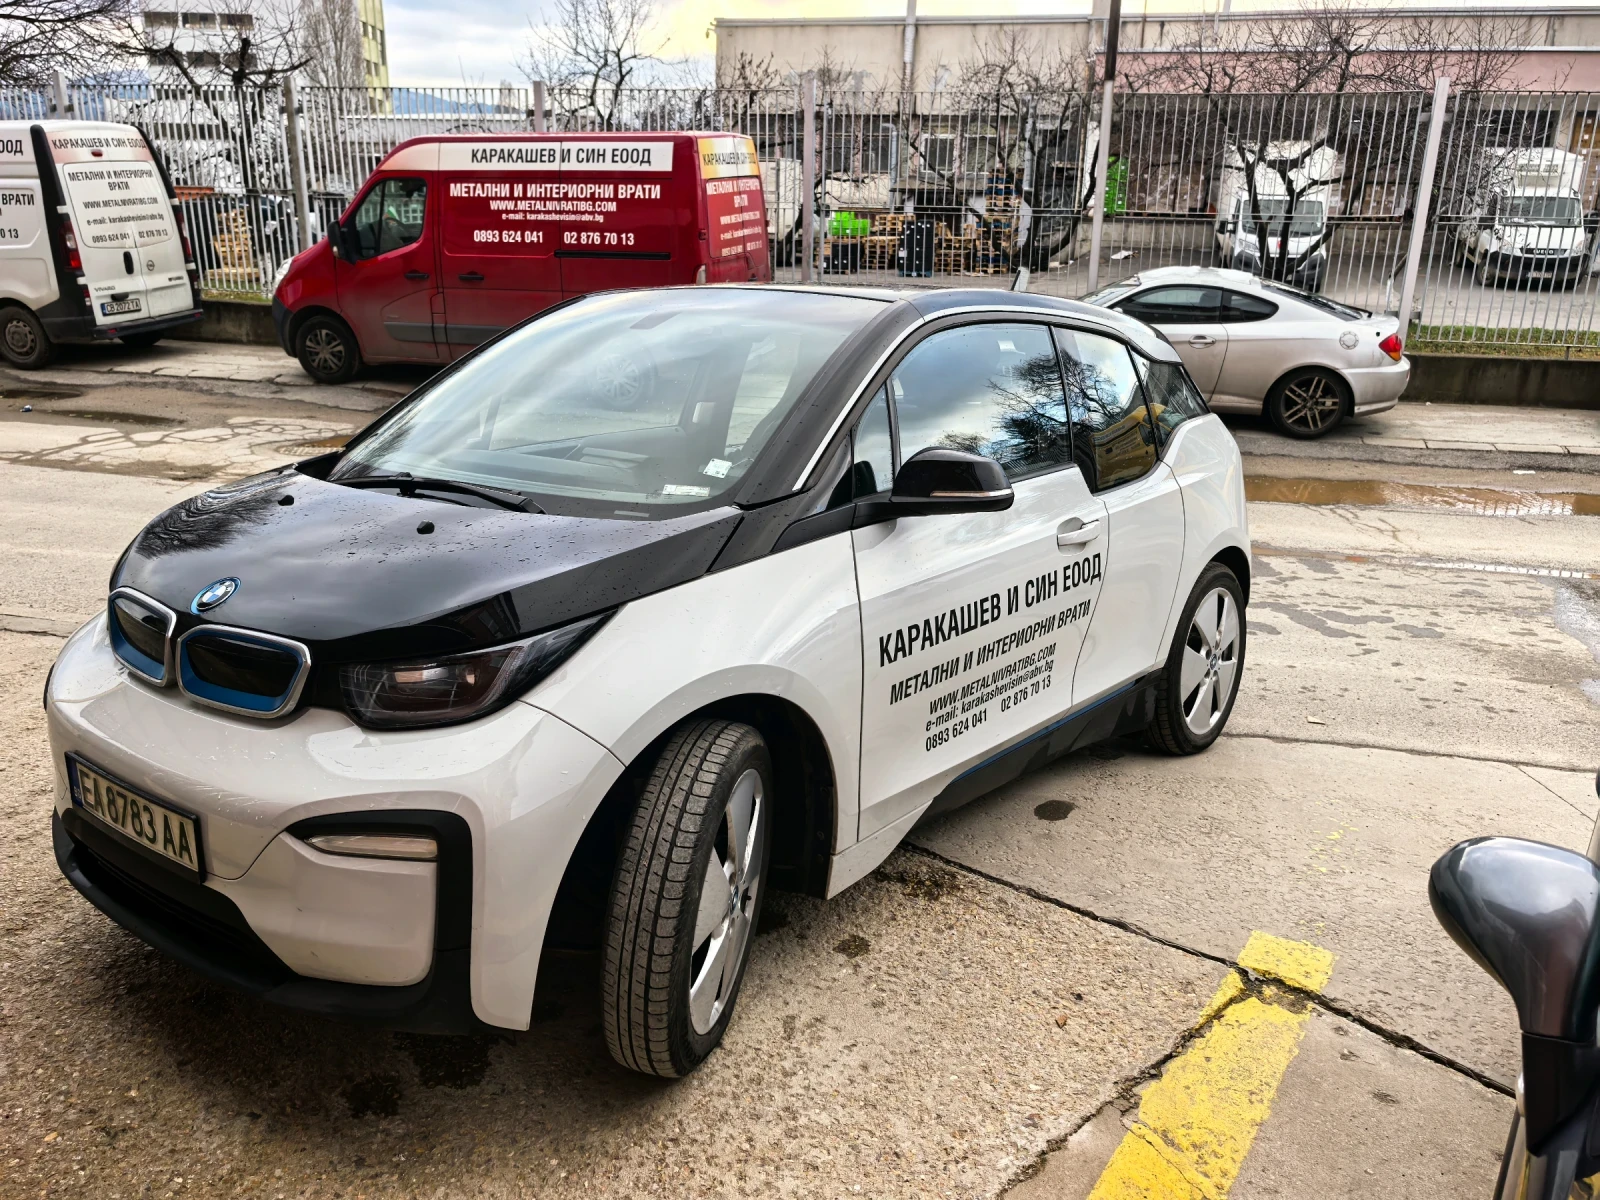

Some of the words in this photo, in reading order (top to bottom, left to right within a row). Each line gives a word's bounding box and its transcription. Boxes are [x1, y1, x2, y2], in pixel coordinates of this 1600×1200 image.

[52, 138, 104, 149] КАРАКАШЕВ
[103, 138, 111, 148] И
[111, 138, 126, 148] СИН
[127, 139, 148, 150] ЕООД
[471, 148, 556, 163] КАРАКАШЕВ
[561, 148, 571, 163] И
[576, 148, 606, 163] СИН
[611, 148, 651, 166] ЕООД
[68, 171, 106, 181] МЕТАЛНИ
[106, 170, 112, 180] И
[112, 170, 154, 179] ИНТЕРИОРНИ
[108, 181, 130, 191] ВРАТИ
[450, 183, 510, 197] МЕТАЛНИ
[514, 184, 524, 198] И
[526, 184, 614, 198] ИНТЕРИОРНИ
[618, 184, 661, 199] ВРАТИ
[2, 194, 35, 206] ВРАТИ
[490, 200, 617, 212] WWW.METALNIVRATIBG.COM
[87, 216, 108, 226] e-mail:
[502, 212, 526, 220] e-mail:
[526, 212, 604, 222] karakashevisin@abv.bg
[8, 229, 19, 238] 13
[92, 235, 107, 244] 0893
[108, 234, 119, 242] 624
[120, 232, 130, 241] 041
[474, 230, 500, 242] 0893
[502, 230, 522, 243] 624
[525, 231, 544, 243] 041
[564, 232, 578, 244] 02
[580, 232, 600, 244] 876
[604, 233, 618, 245] 70
[620, 233, 634, 245] 13
[879, 593, 1001, 667] КАРАКАШЕВ
[1007, 586, 1019, 616] И
[1025, 570, 1058, 608] СИН
[1063, 553, 1102, 593] ЕООД
[890, 656, 960, 705] МЕТАЛНИ
[963, 651, 974, 673] И
[976, 614, 1056, 666] ИНТЕРИОРНИ
[1057, 599, 1092, 630] ВРАТИ
[930, 642, 1057, 715] WWW.METALNIVRATIBG.COM
[926, 708, 959, 732] e-mail:
[961, 659, 1054, 714] karakashevisin@abv.bg
[1001, 698, 1012, 712] 02
[1014, 686, 1028, 706] 876
[1031, 681, 1040, 697] 70
[1042, 675, 1052, 690] 13
[926, 733, 950, 752] 0893
[952, 721, 970, 739] 624
[972, 708, 988, 728] 041
[106, 786, 157, 844] 8783
[164, 813, 194, 865] AA
